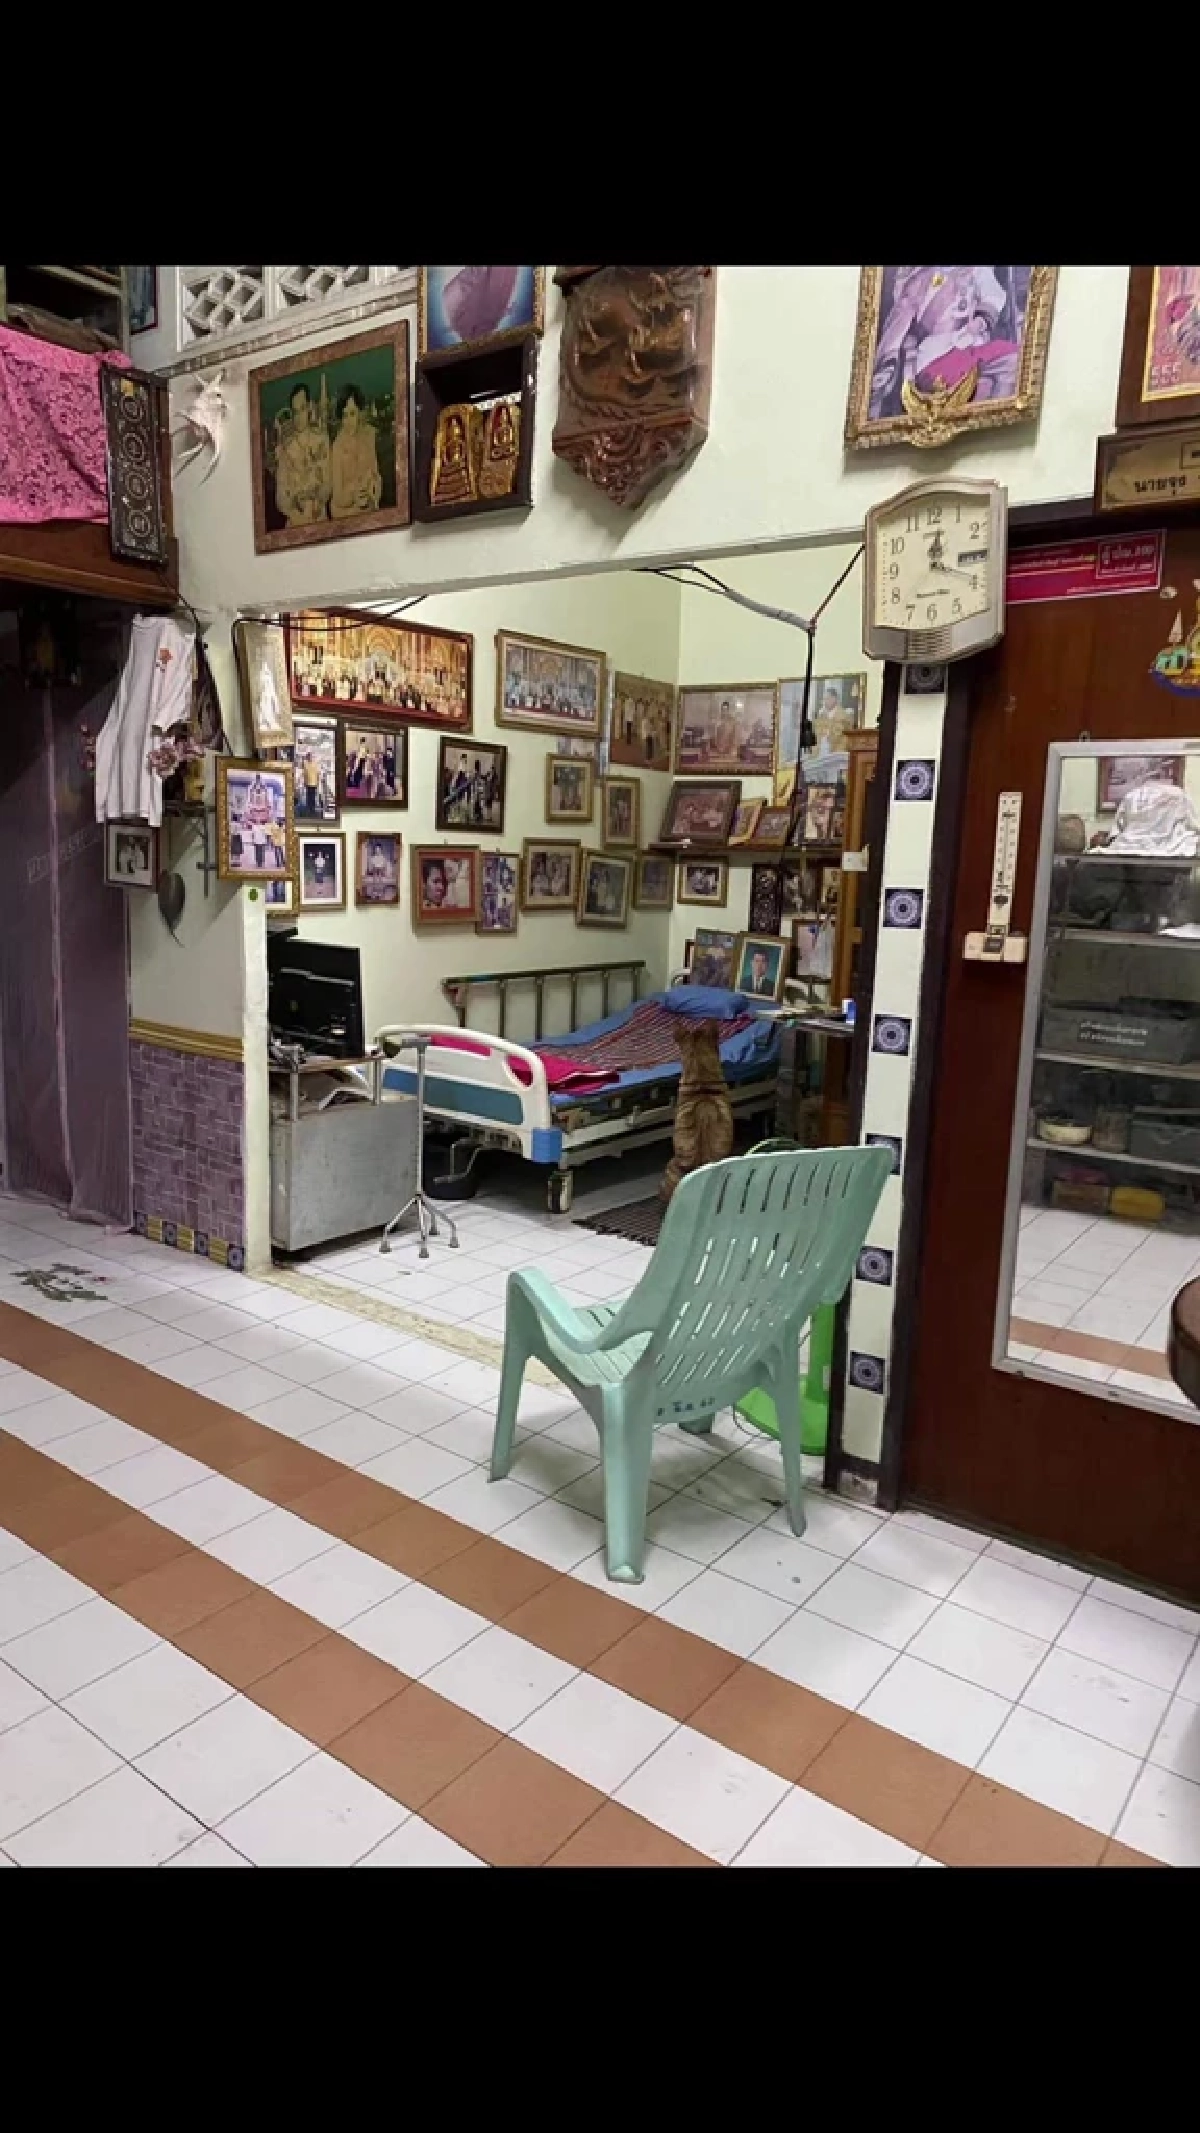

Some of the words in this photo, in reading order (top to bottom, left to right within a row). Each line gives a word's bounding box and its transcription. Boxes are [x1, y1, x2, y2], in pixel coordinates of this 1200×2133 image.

[906, 513, 920, 533] 11
[926, 506, 943, 526] 12
[956, 505, 961, 523] 1
[969, 522, 980, 540] 2
[890, 536, 905, 555] 10
[889, 561, 899, 580] 9
[968, 574, 978, 591] 4
[891, 587, 901, 605] 8
[905, 603, 916, 621] 7
[926, 603, 938, 621] 6
[952, 597, 963, 616] 5
